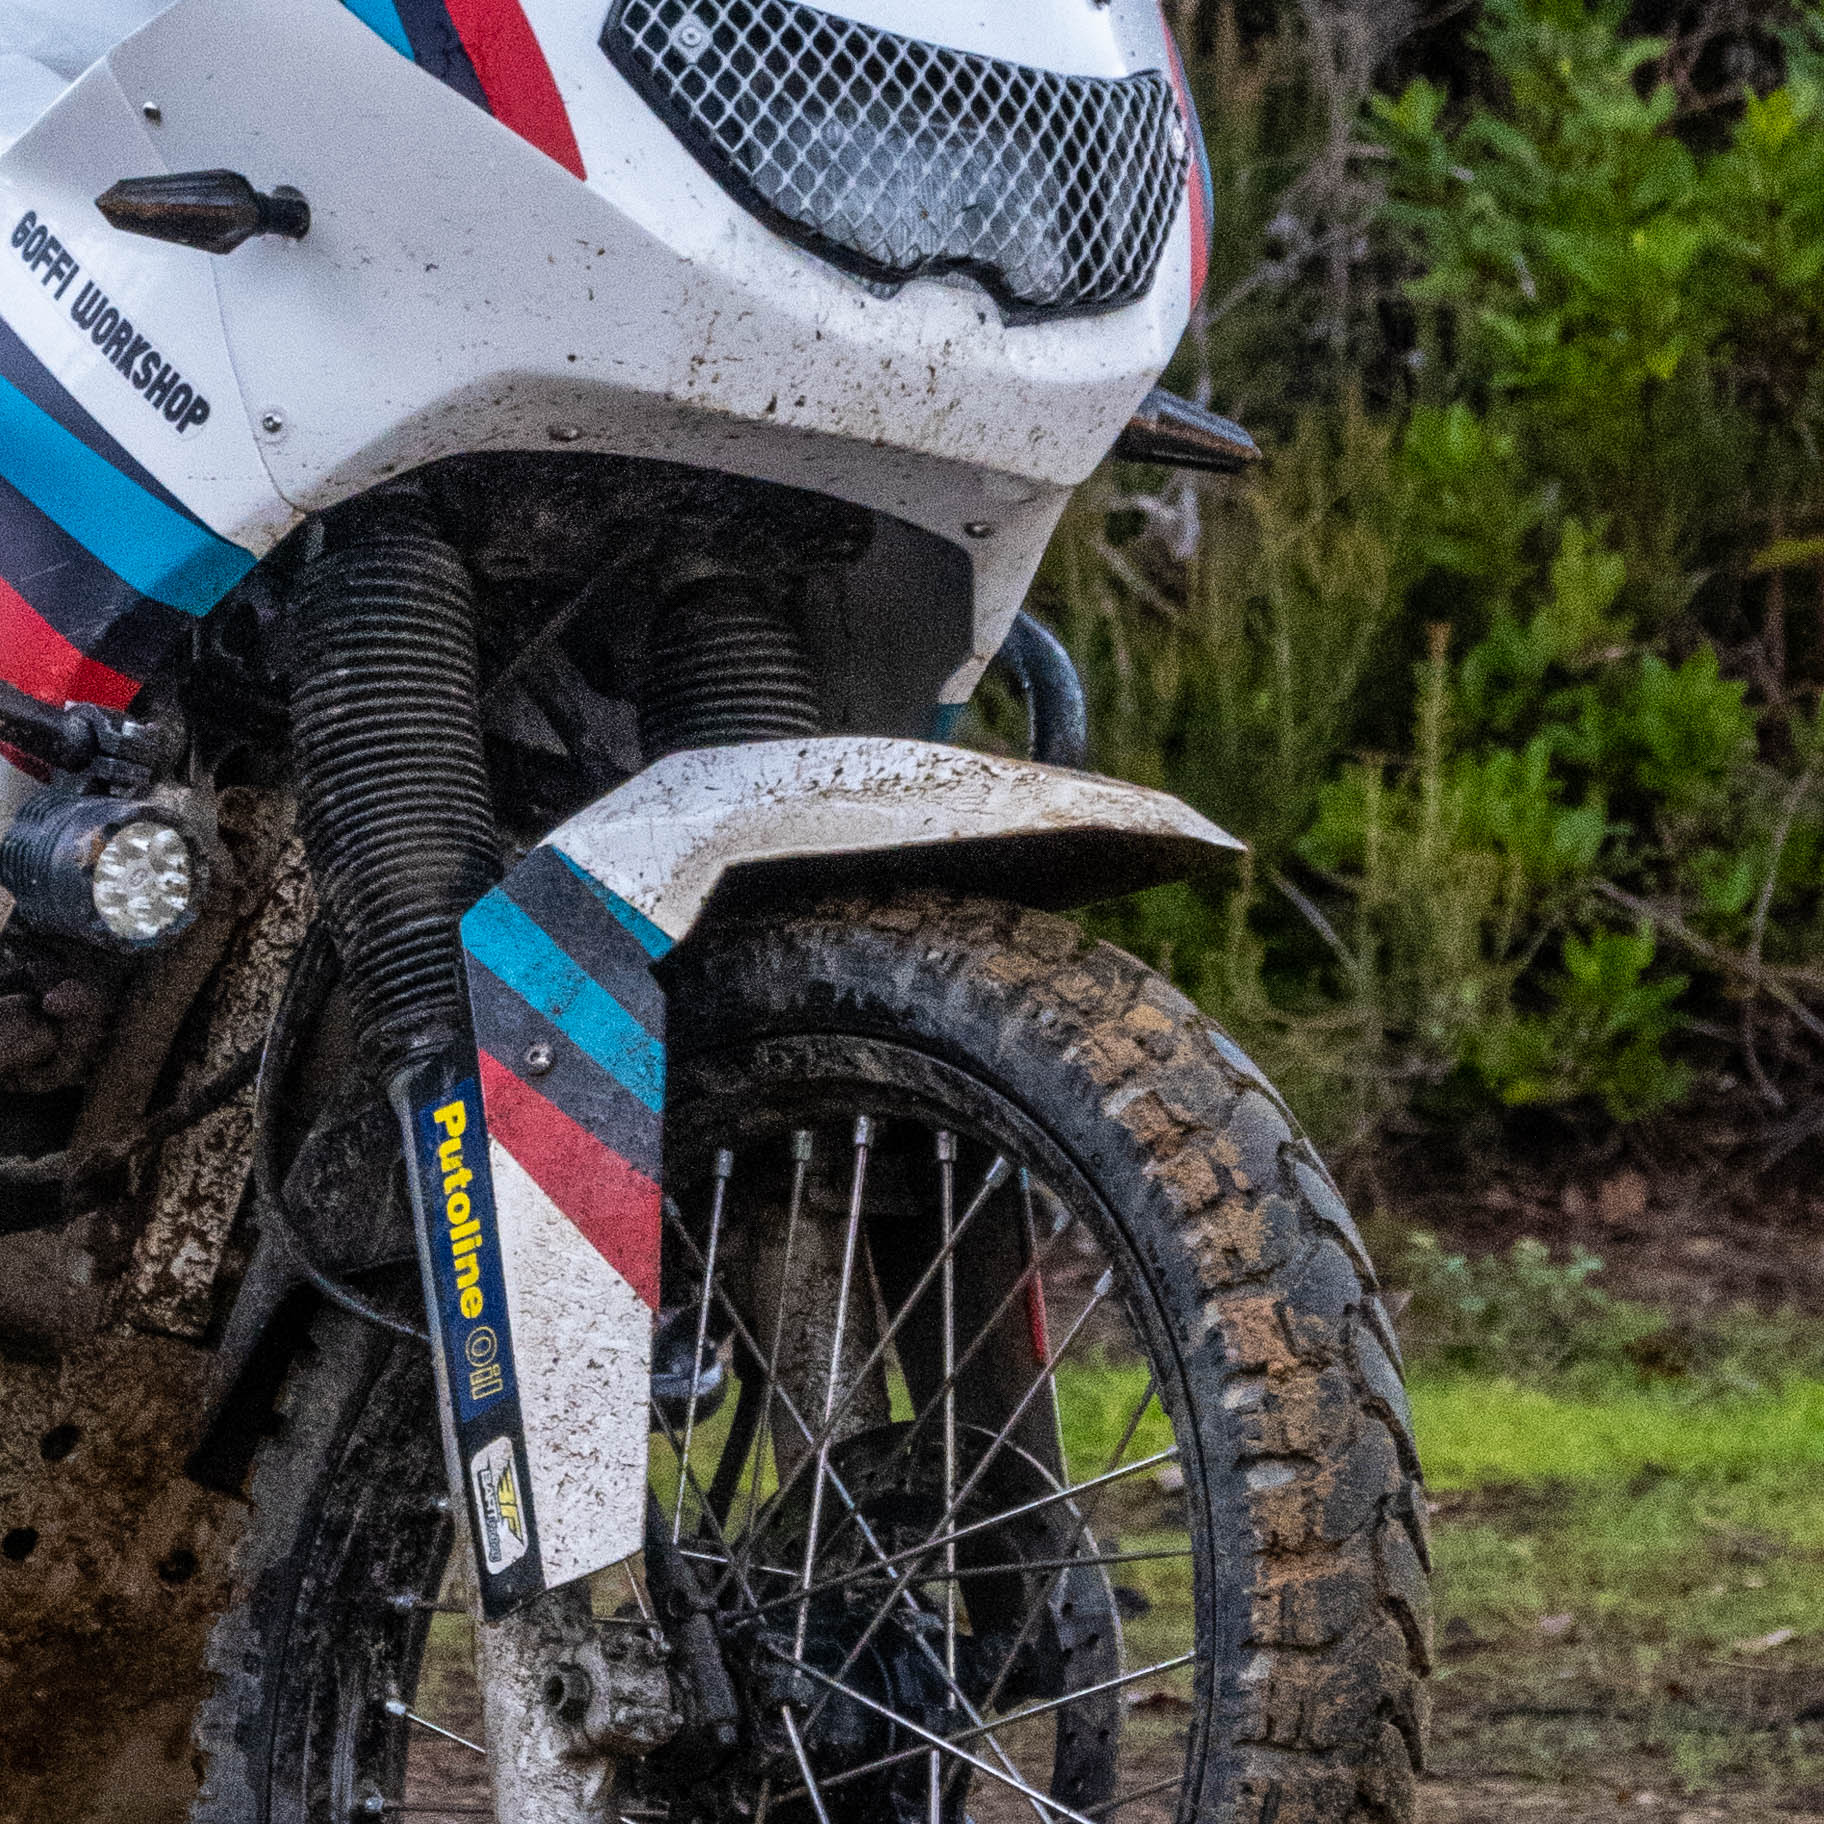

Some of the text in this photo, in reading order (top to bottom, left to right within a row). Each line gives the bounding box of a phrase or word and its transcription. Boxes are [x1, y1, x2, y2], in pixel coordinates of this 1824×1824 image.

[10, 209, 212, 434] GOFFI WORKSHOP
[432, 1099, 505, 1401] Putoline Oil
